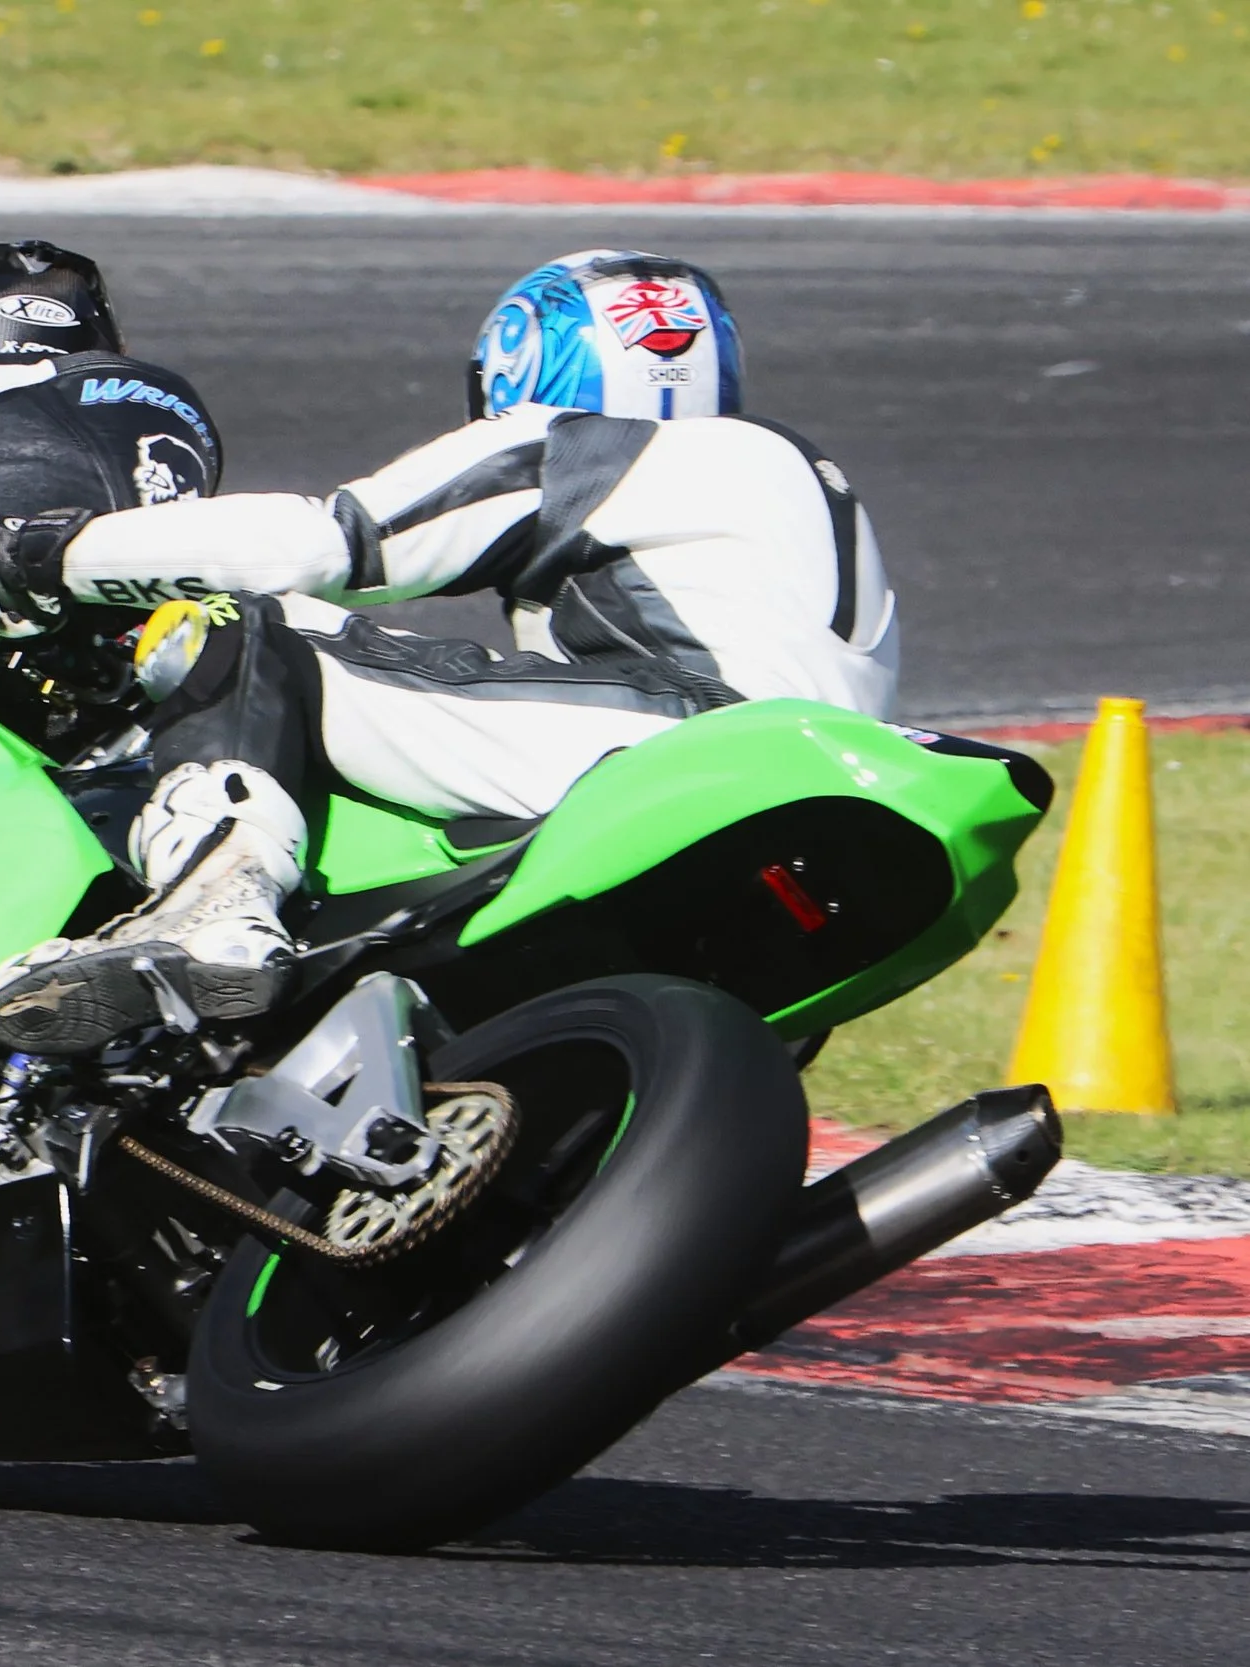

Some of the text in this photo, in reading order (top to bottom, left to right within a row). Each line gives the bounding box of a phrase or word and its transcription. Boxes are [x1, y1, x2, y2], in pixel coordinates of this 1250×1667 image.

[4, 298, 66, 322] X-lite
[648, 368, 691, 382] SHOEI
[92, 577, 213, 604] BKS
